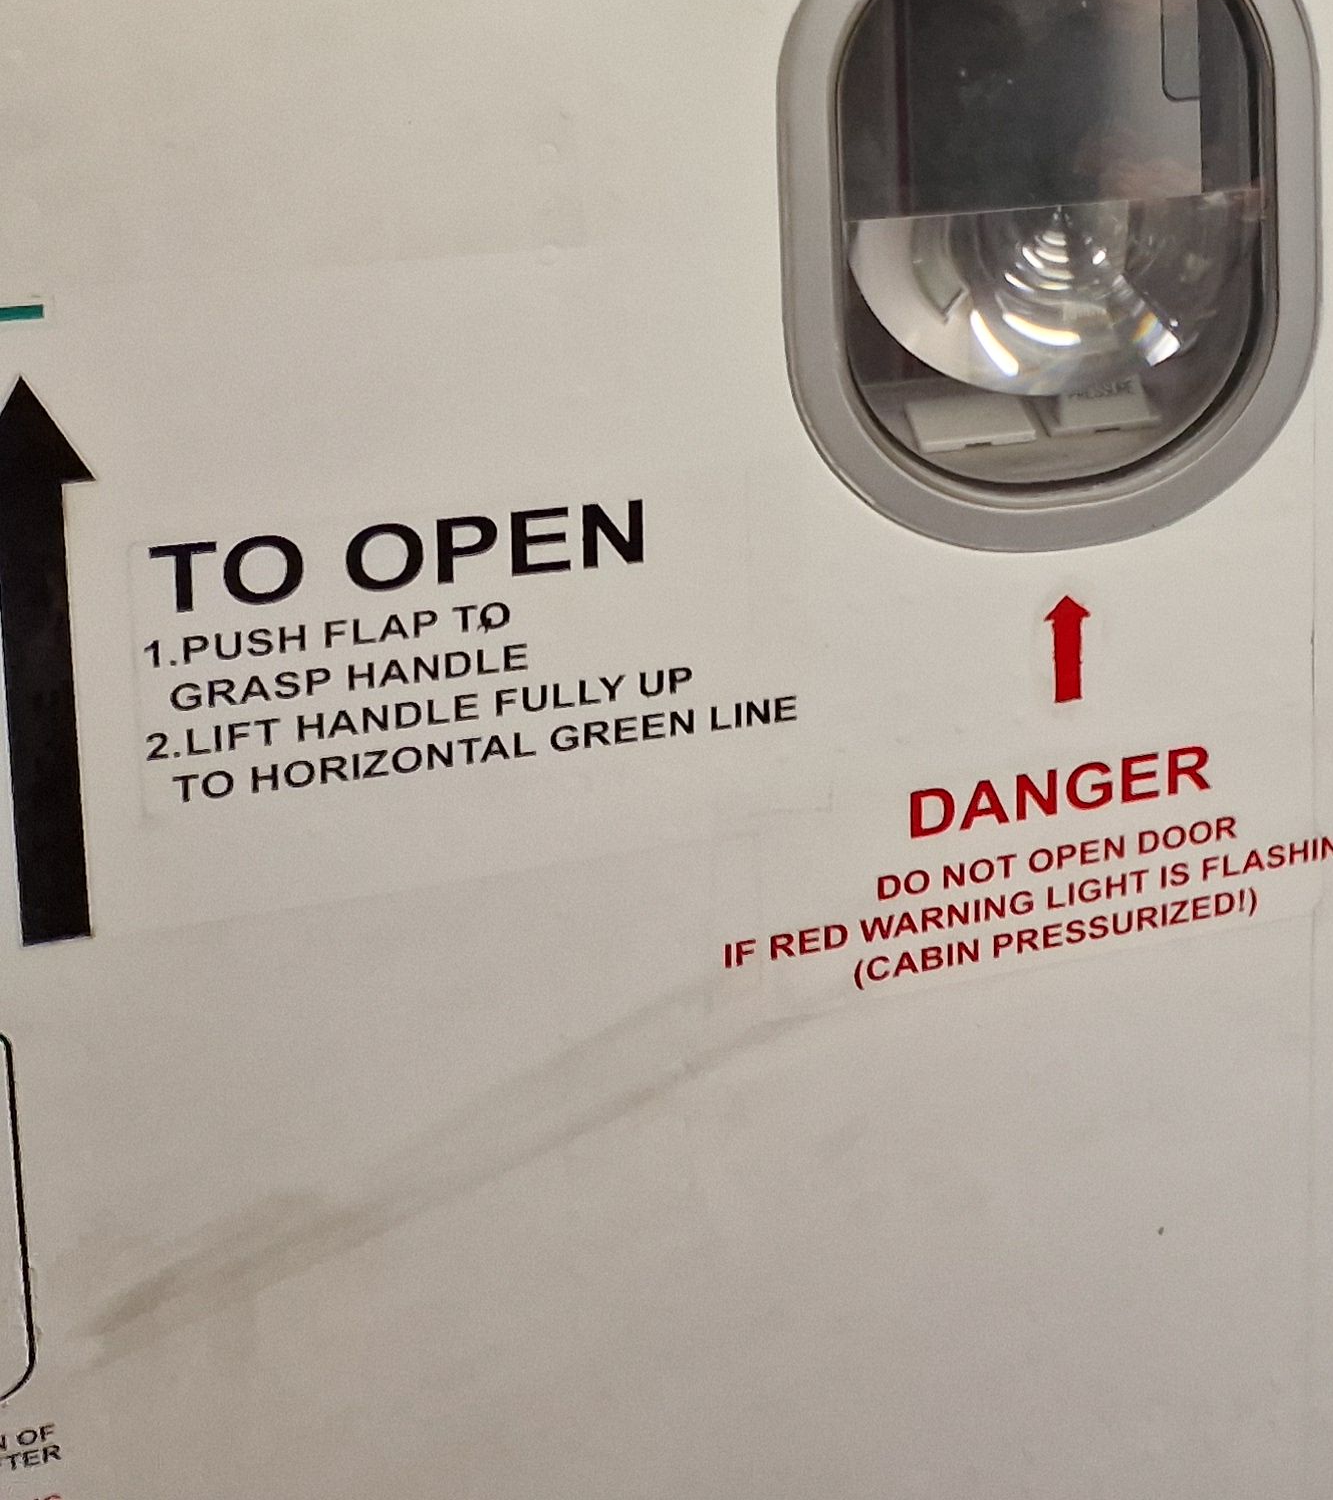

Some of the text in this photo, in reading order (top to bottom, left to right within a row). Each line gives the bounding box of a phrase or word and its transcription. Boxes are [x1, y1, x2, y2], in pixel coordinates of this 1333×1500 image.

[148, 498, 644, 613] TO OPEN
[143, 601, 511, 668] 1.PUSH FLAP TO
[169, 643, 528, 712] GRASP HANDLE
[146, 666, 693, 762] 2.LIFT HANDLE FULLY UP
[172, 695, 797, 803] TO HORIZONTAL GREEN LINE
[908, 743, 1210, 841] DANGER
[876, 816, 1237, 902] DO NOT OPEN DOOR
[723, 939, 758, 969] IF
[770, 923, 850, 961] RED
[859, 890, 1036, 944] WARNING
[1045, 869, 1147, 912] LIGHT
[1159, 863, 1191, 890] IS
[854, 889, 1259, 990] (CABIN PRESSURIZED!)
[0, 1444, 62, 1471] TER
[16, 1423, 55, 1446] OF
